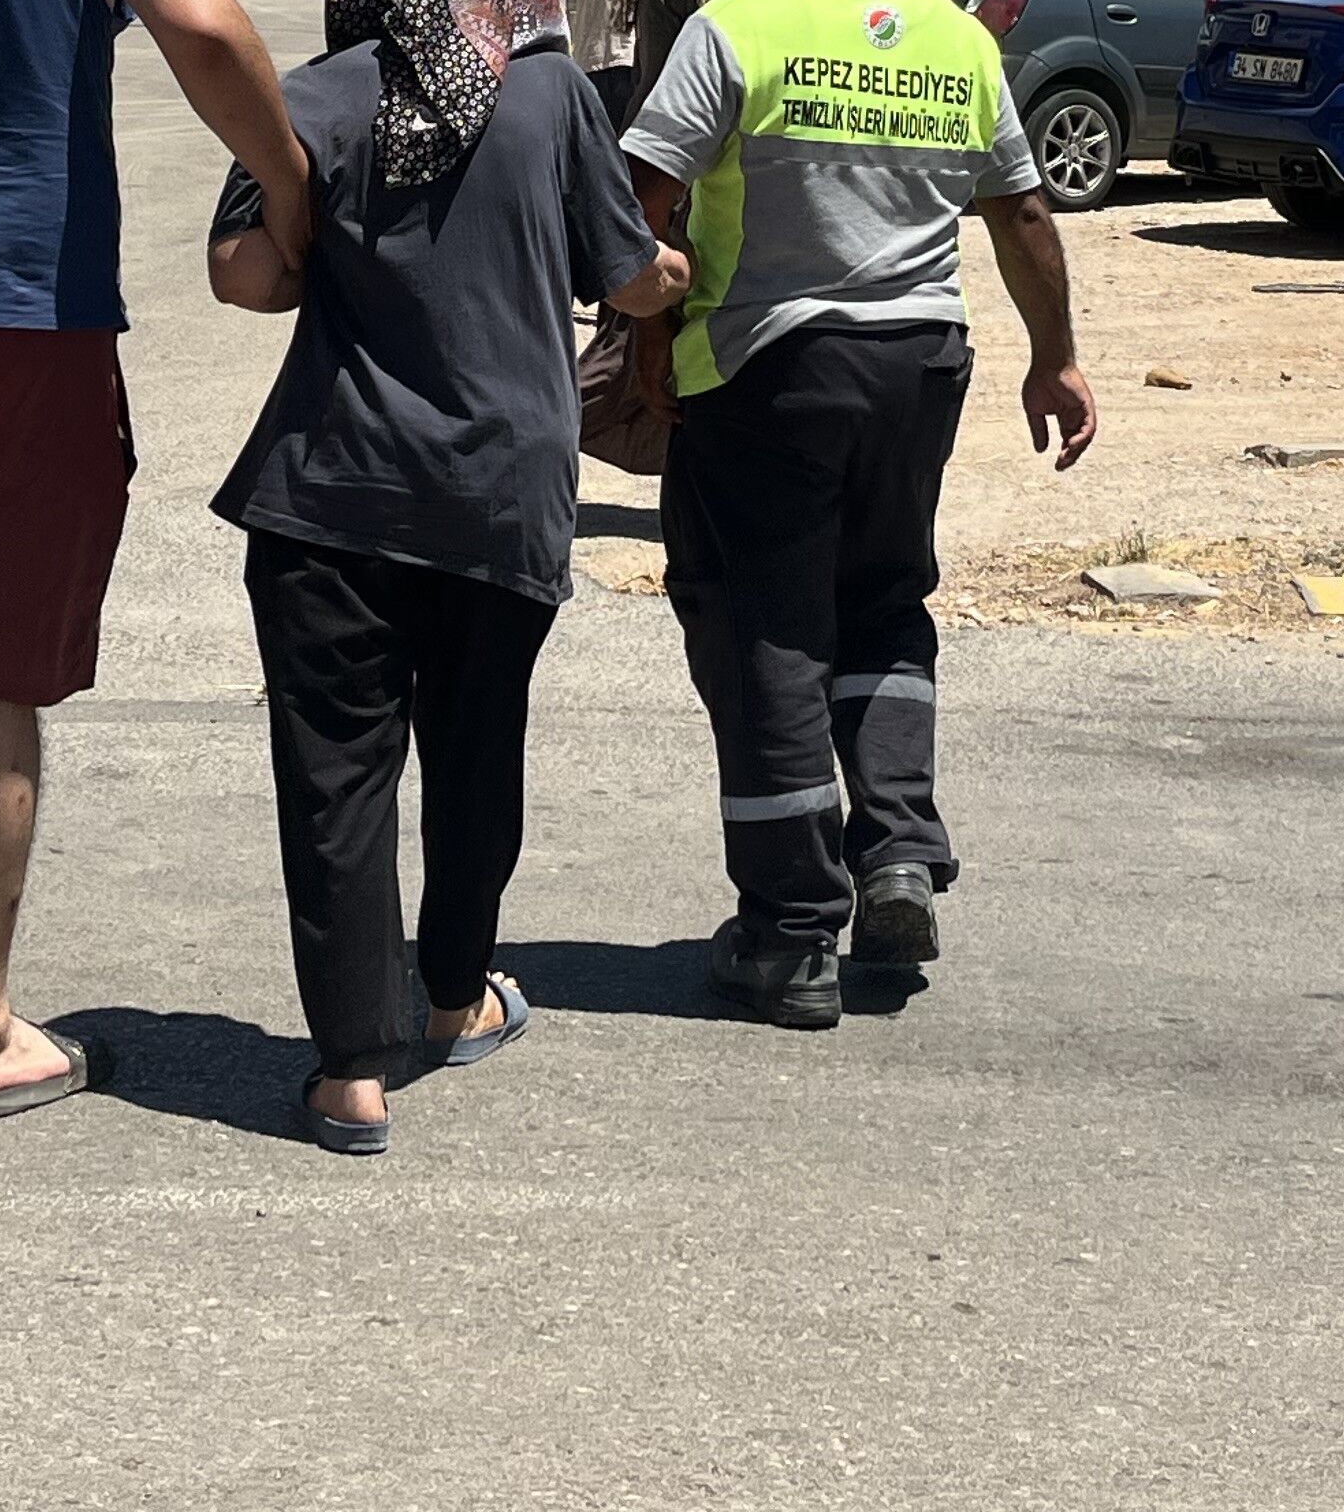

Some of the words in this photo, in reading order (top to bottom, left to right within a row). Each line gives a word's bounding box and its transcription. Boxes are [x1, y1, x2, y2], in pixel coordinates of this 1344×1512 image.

[783, 56, 853, 91] KEPEZ
[857, 63, 974, 107] BELEDİYESİ
[1233, 55, 1247, 75] 34
[782, 94, 845, 131] TEMİZLİK
[846, 98, 887, 140] İŞLERİ
[888, 105, 970, 146] MÜDÜRLÜĞÜ
